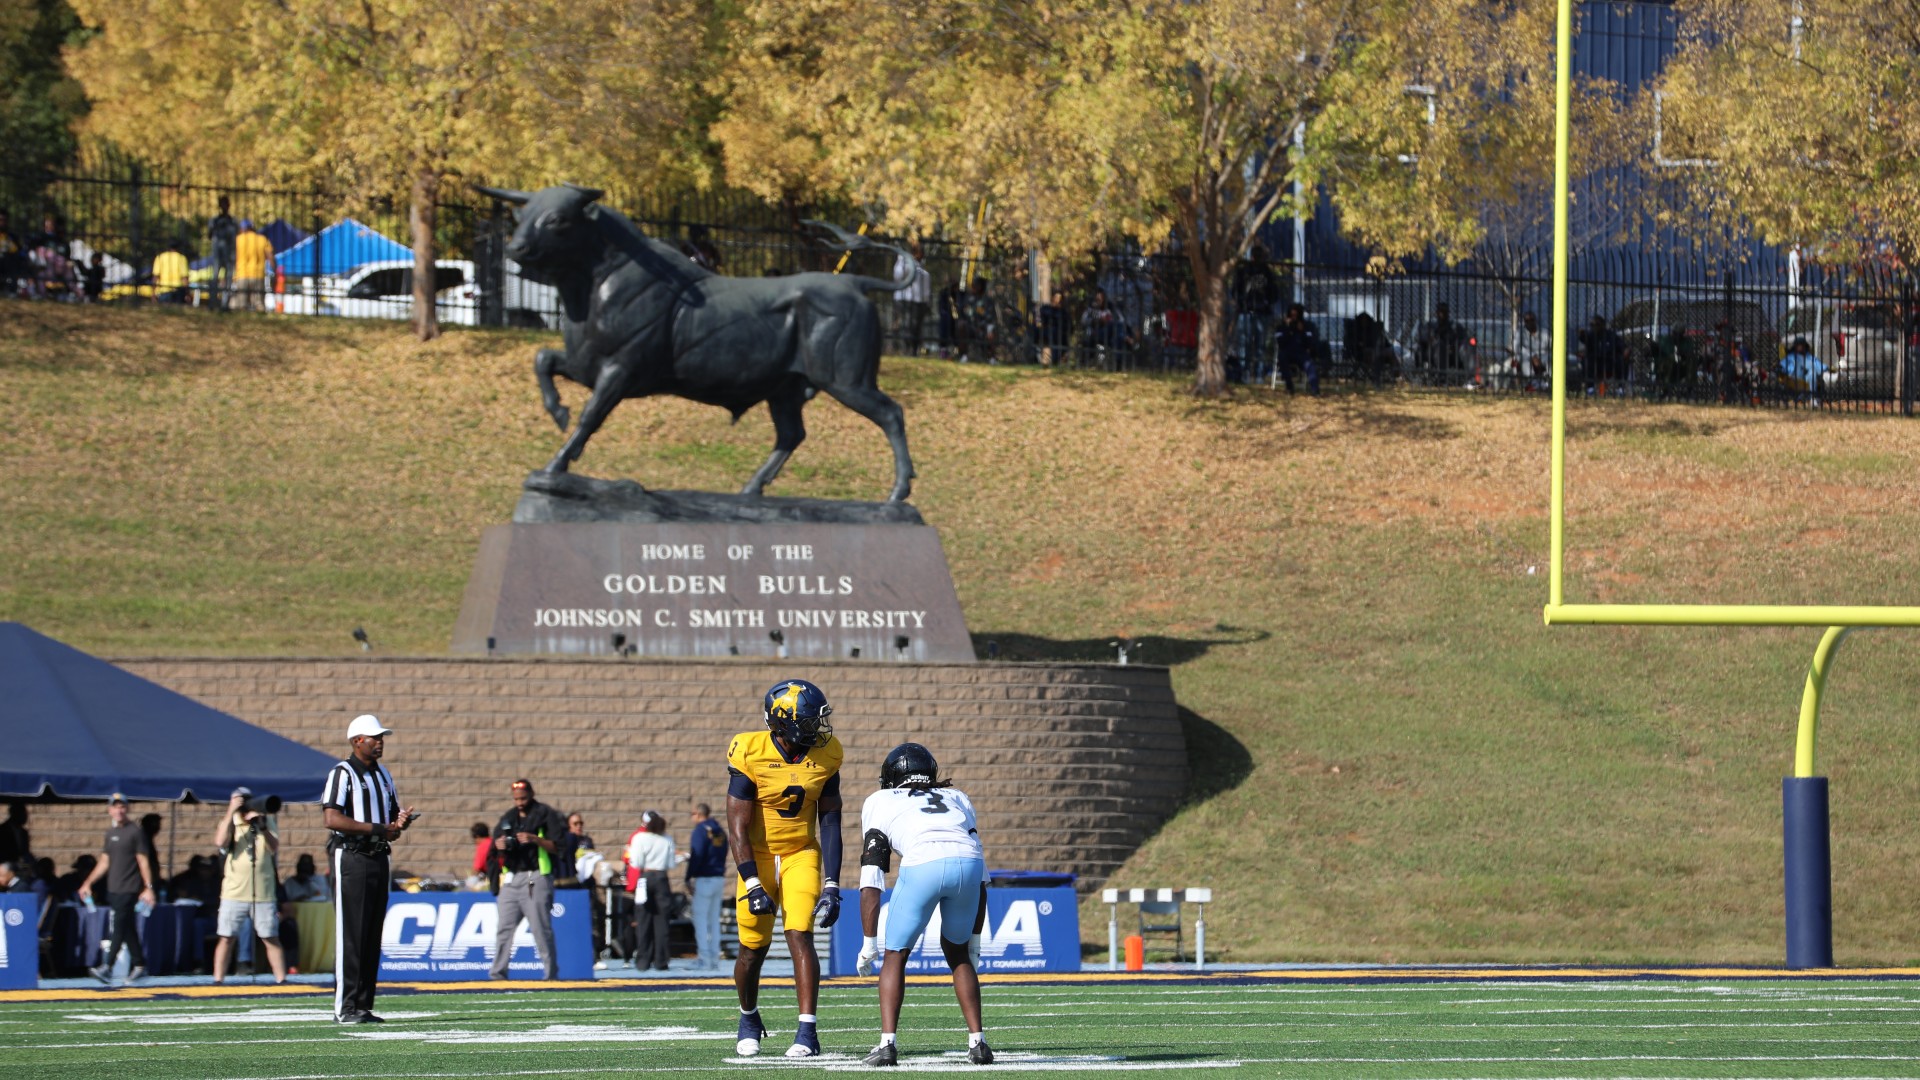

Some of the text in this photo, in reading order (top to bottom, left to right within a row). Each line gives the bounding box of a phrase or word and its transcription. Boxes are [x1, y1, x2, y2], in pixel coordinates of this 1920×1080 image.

[641, 544, 813, 560] HOME OF THE
[603, 574, 853, 595] GOLDEN BULLS
[534, 609, 928, 628] JOHNSON C. SMITH UNIVERSITY
[776, 785, 806, 818] 3
[913, 788, 950, 814] 3
